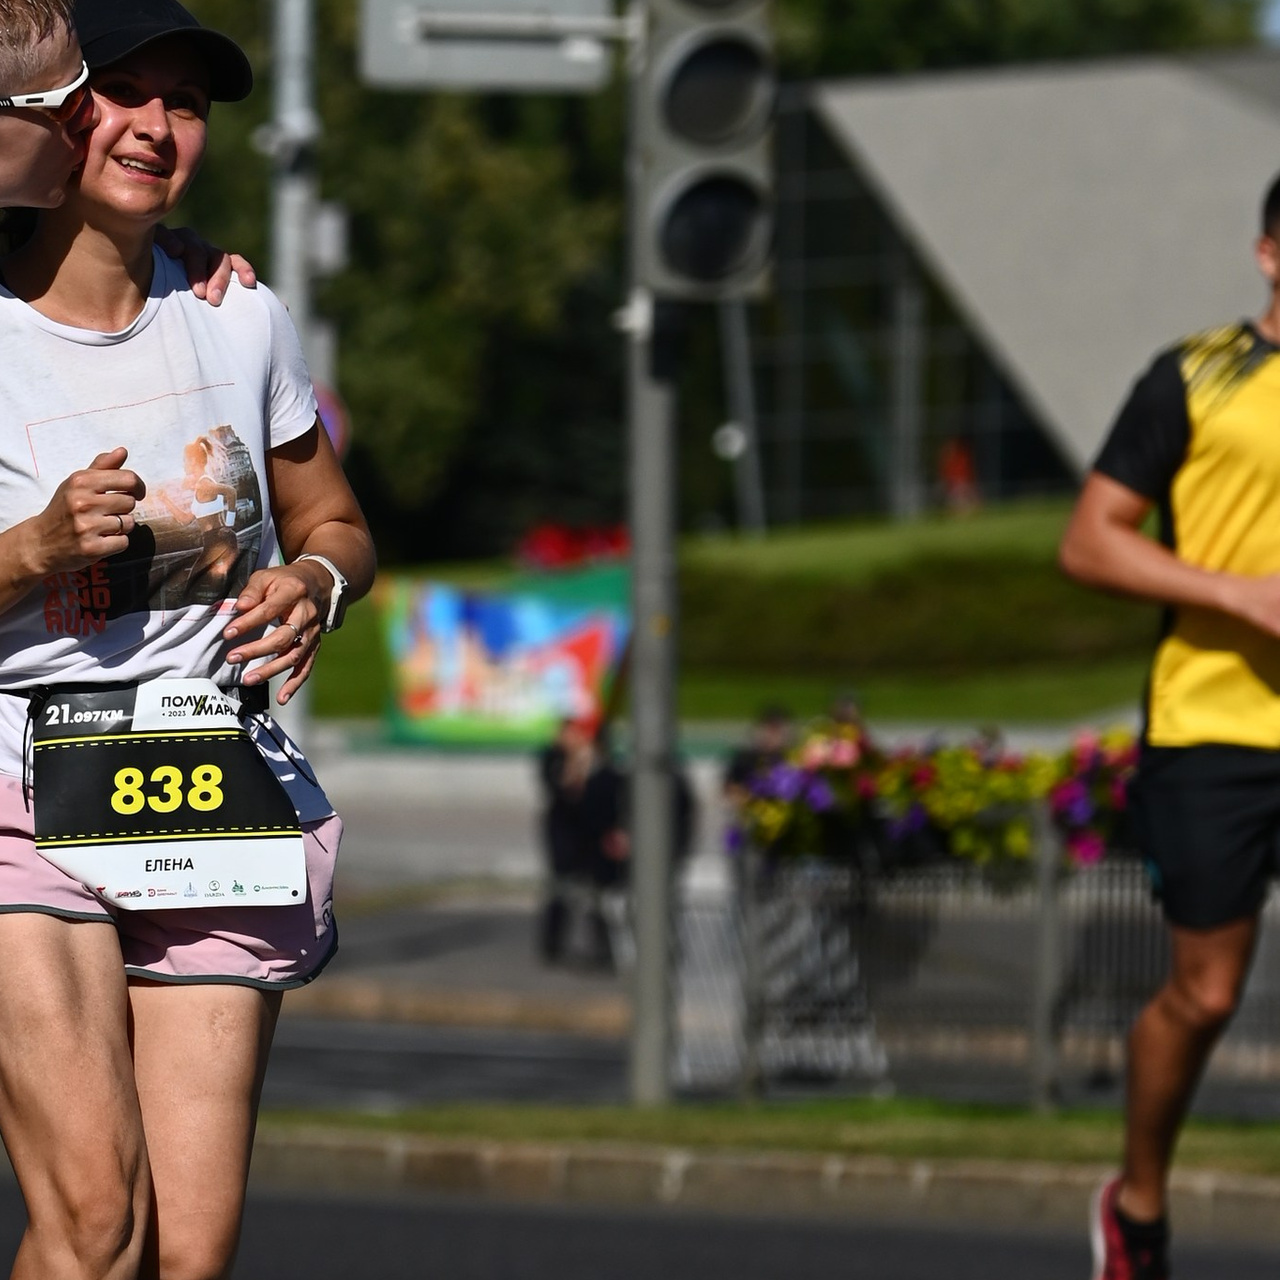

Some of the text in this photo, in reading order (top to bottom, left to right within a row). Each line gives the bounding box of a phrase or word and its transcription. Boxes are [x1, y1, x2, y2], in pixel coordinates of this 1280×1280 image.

[44, 587, 111, 612] AND
[45, 609, 107, 637] RUN
[111, 764, 224, 814] 838
[145, 857, 194, 872] ЕЛЕНА
